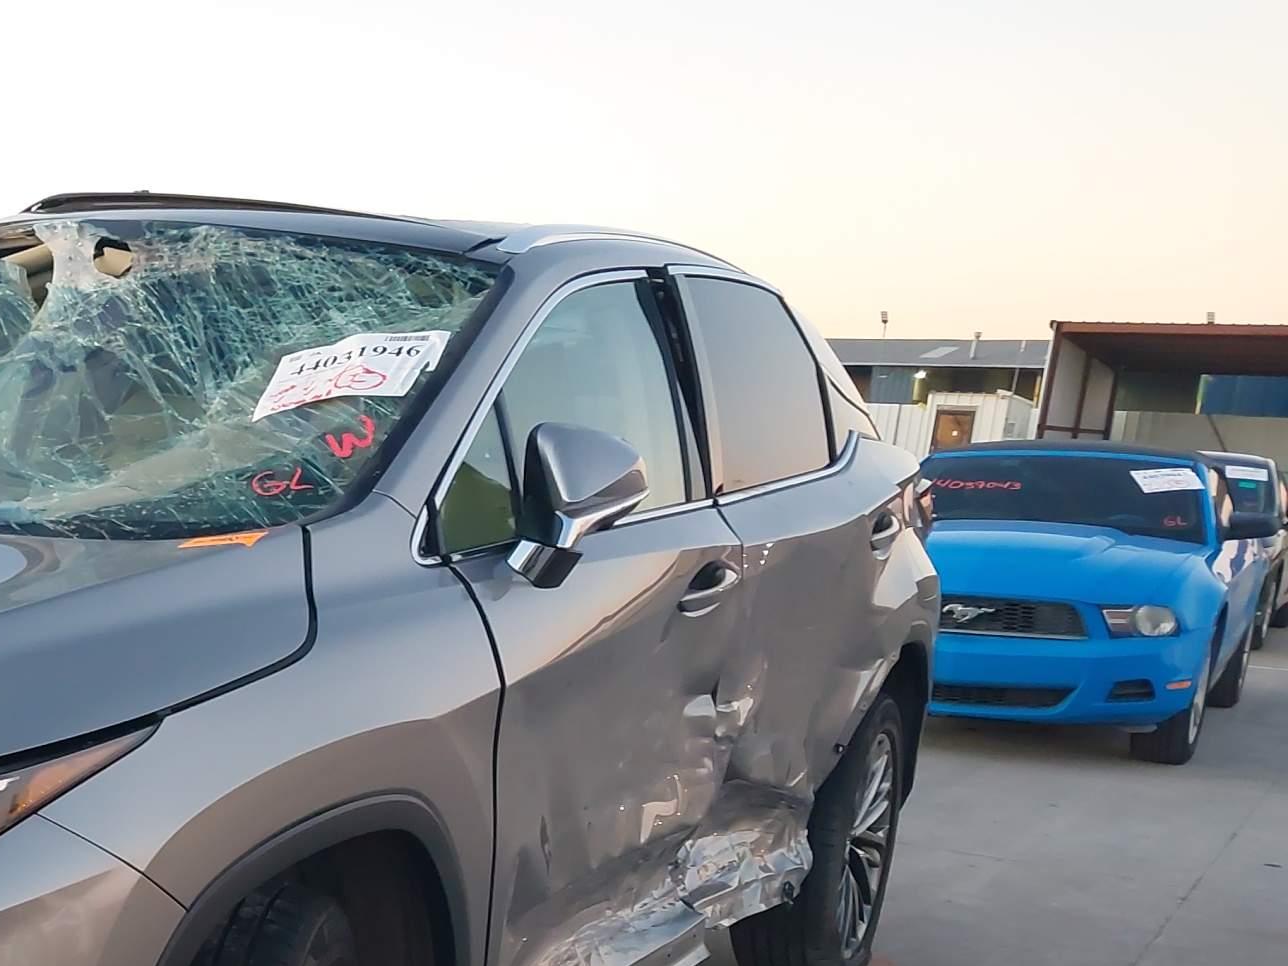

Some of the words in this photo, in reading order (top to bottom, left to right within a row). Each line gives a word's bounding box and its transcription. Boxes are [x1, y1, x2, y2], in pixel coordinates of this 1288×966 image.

[290, 344, 424, 377] 44031946
[325, 414, 376, 458] W
[251, 466, 314, 496] GL
